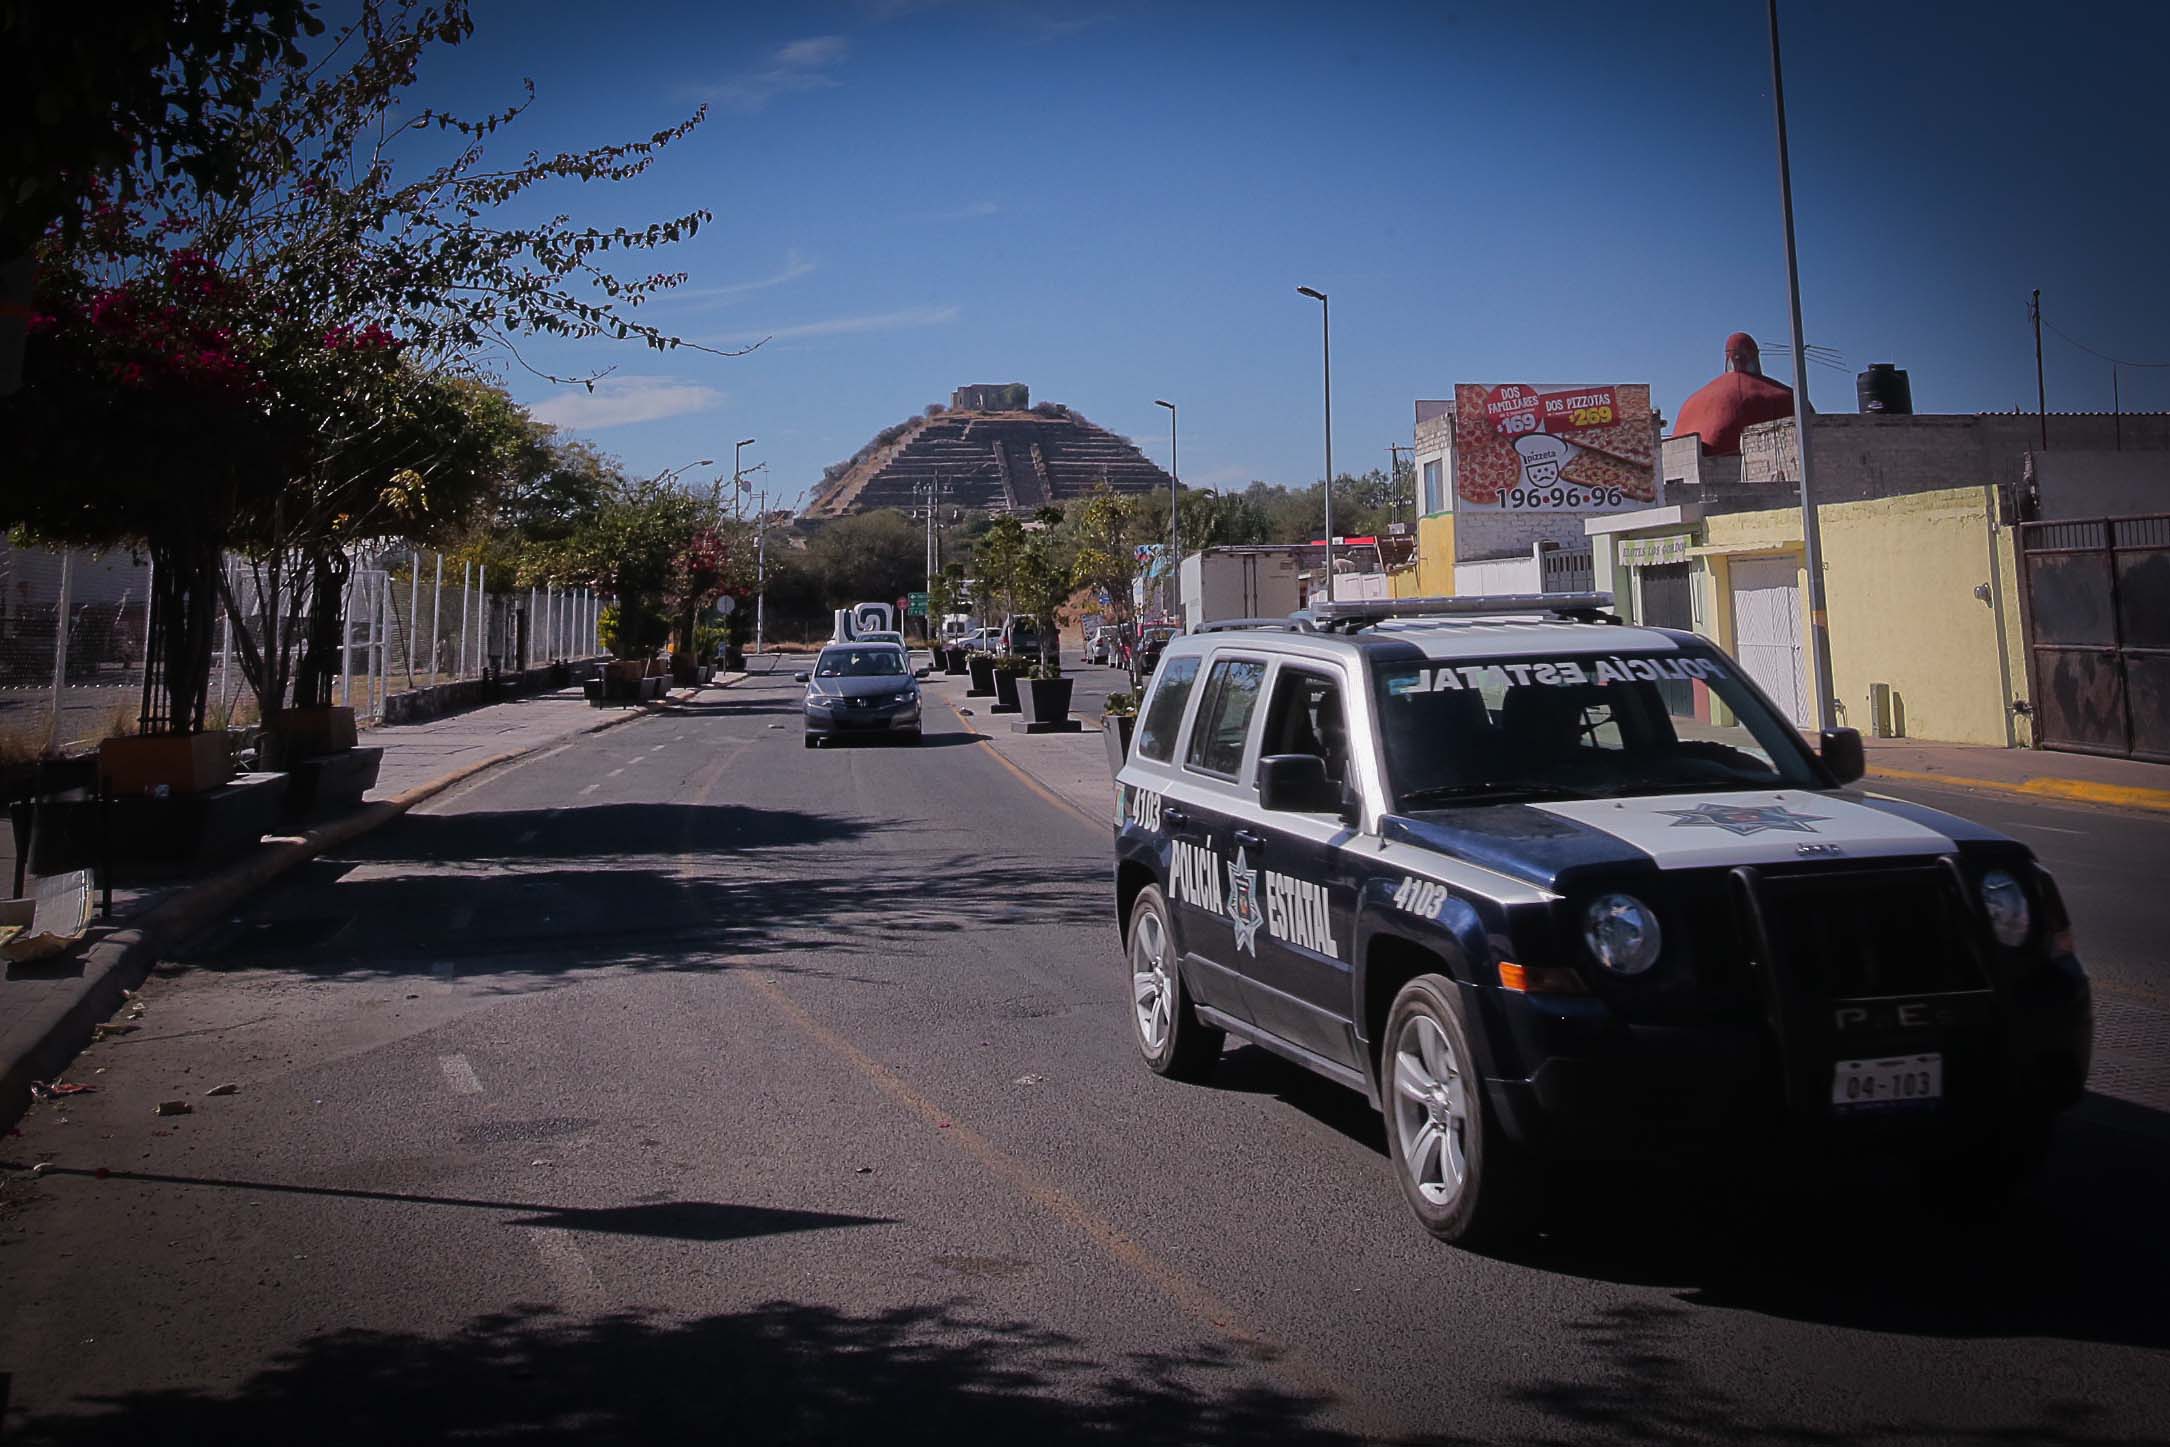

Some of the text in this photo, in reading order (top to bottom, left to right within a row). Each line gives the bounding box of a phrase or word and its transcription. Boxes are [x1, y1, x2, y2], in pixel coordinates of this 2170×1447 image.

[1501, 386, 1520, 400] DOS
[1545, 393, 1611, 411] DOS PIZZOTAS
[1487, 395, 1539, 414] FAMILIARES
[1527, 450, 1556, 463] pizzeta
[1132, 787, 1161, 832] 4103
[1168, 834, 1338, 959] POLICÍA ESTATAL
[1393, 876, 1448, 919] 4103
